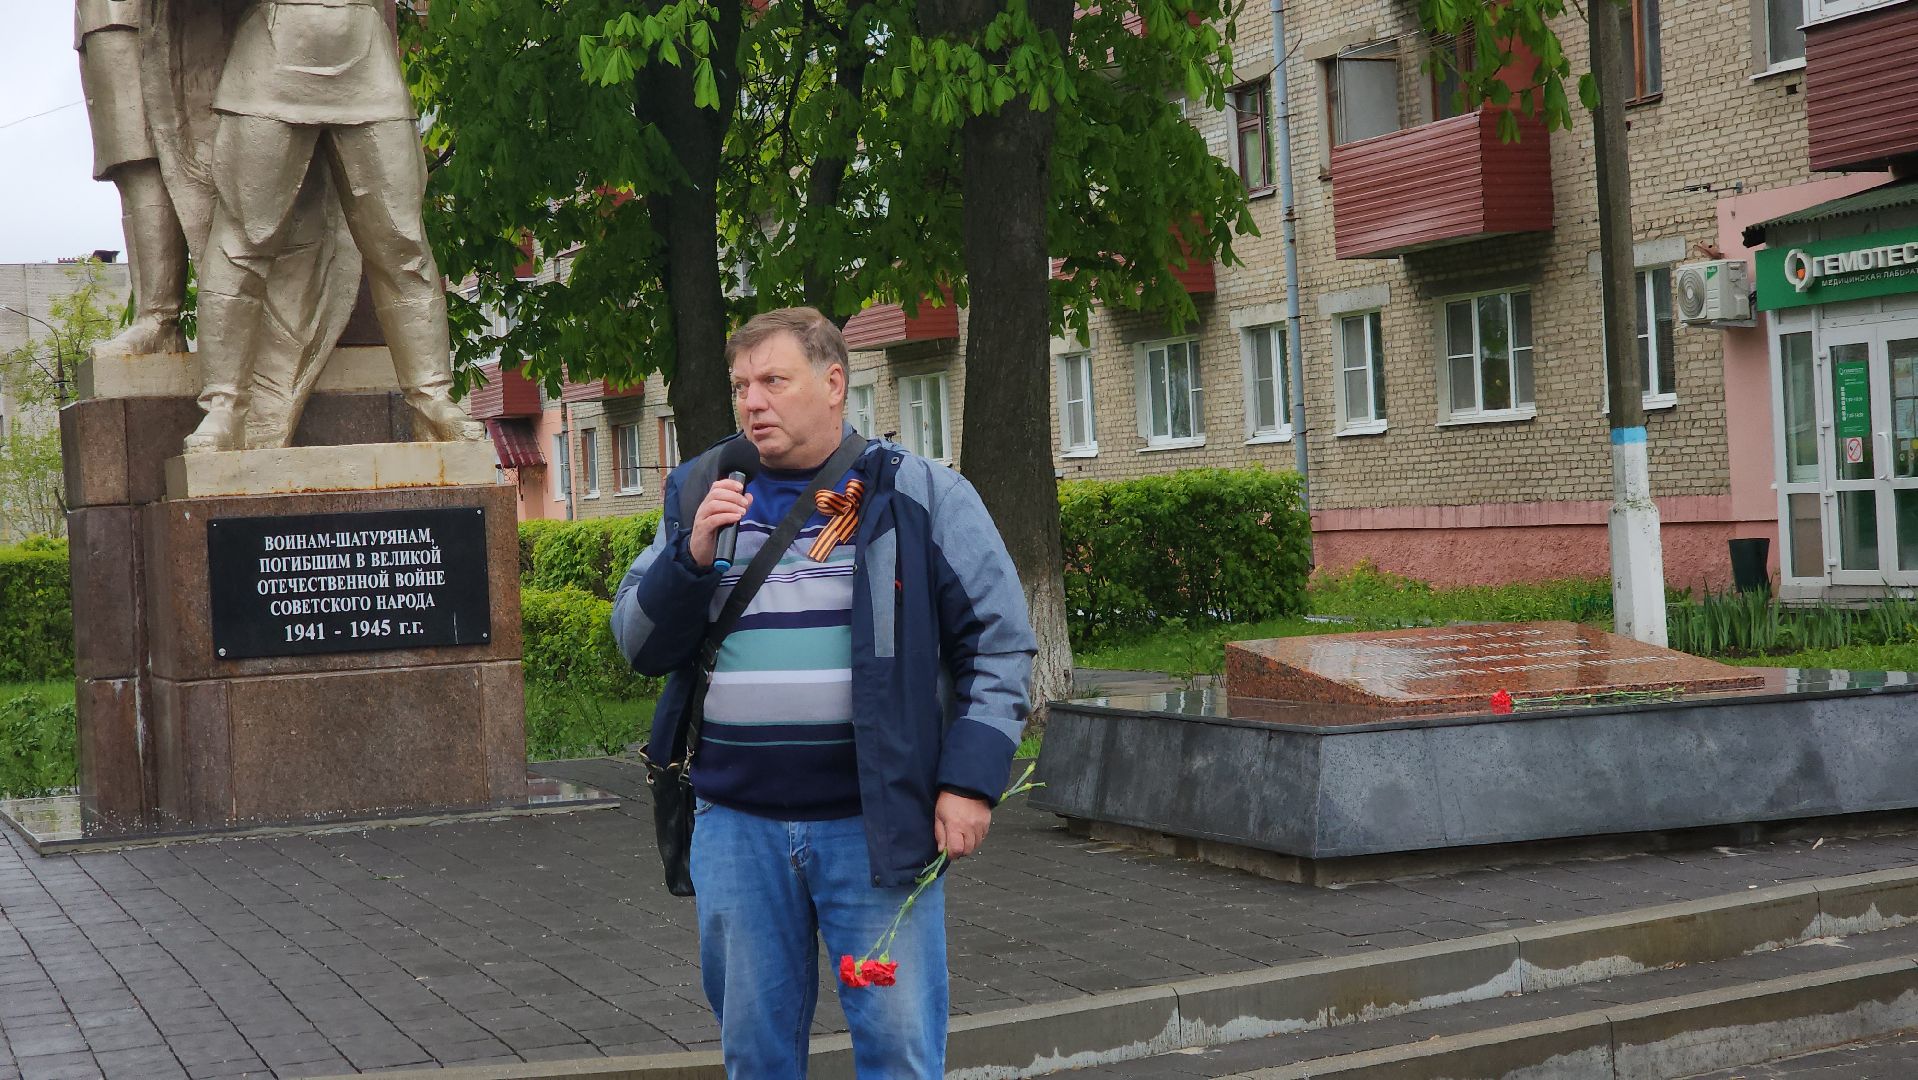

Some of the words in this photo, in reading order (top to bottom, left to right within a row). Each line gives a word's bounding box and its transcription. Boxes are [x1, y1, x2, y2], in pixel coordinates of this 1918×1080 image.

[1822, 274, 1880, 286] МЕДИЦИНСКАЯ
[265, 528, 434, 551] ВОИНАМ-ШАТУРЯНАМ,
[259, 554, 350, 572] ПОГИБШИМ
[356, 553, 365, 567] В
[371, 546, 441, 566] ВЕЛИКОЙ
[257, 572, 389, 594] ОТЕЧЕСТВЕННОЙ
[395, 568, 445, 587] ВОЙНЕ
[271, 596, 370, 615] СОВЕТСКОГО
[377, 593, 435, 610] НАРОДА
[285, 623, 325, 641] 1941
[350, 620, 391, 637] 1945
[399, 622, 424, 634] г.г.
